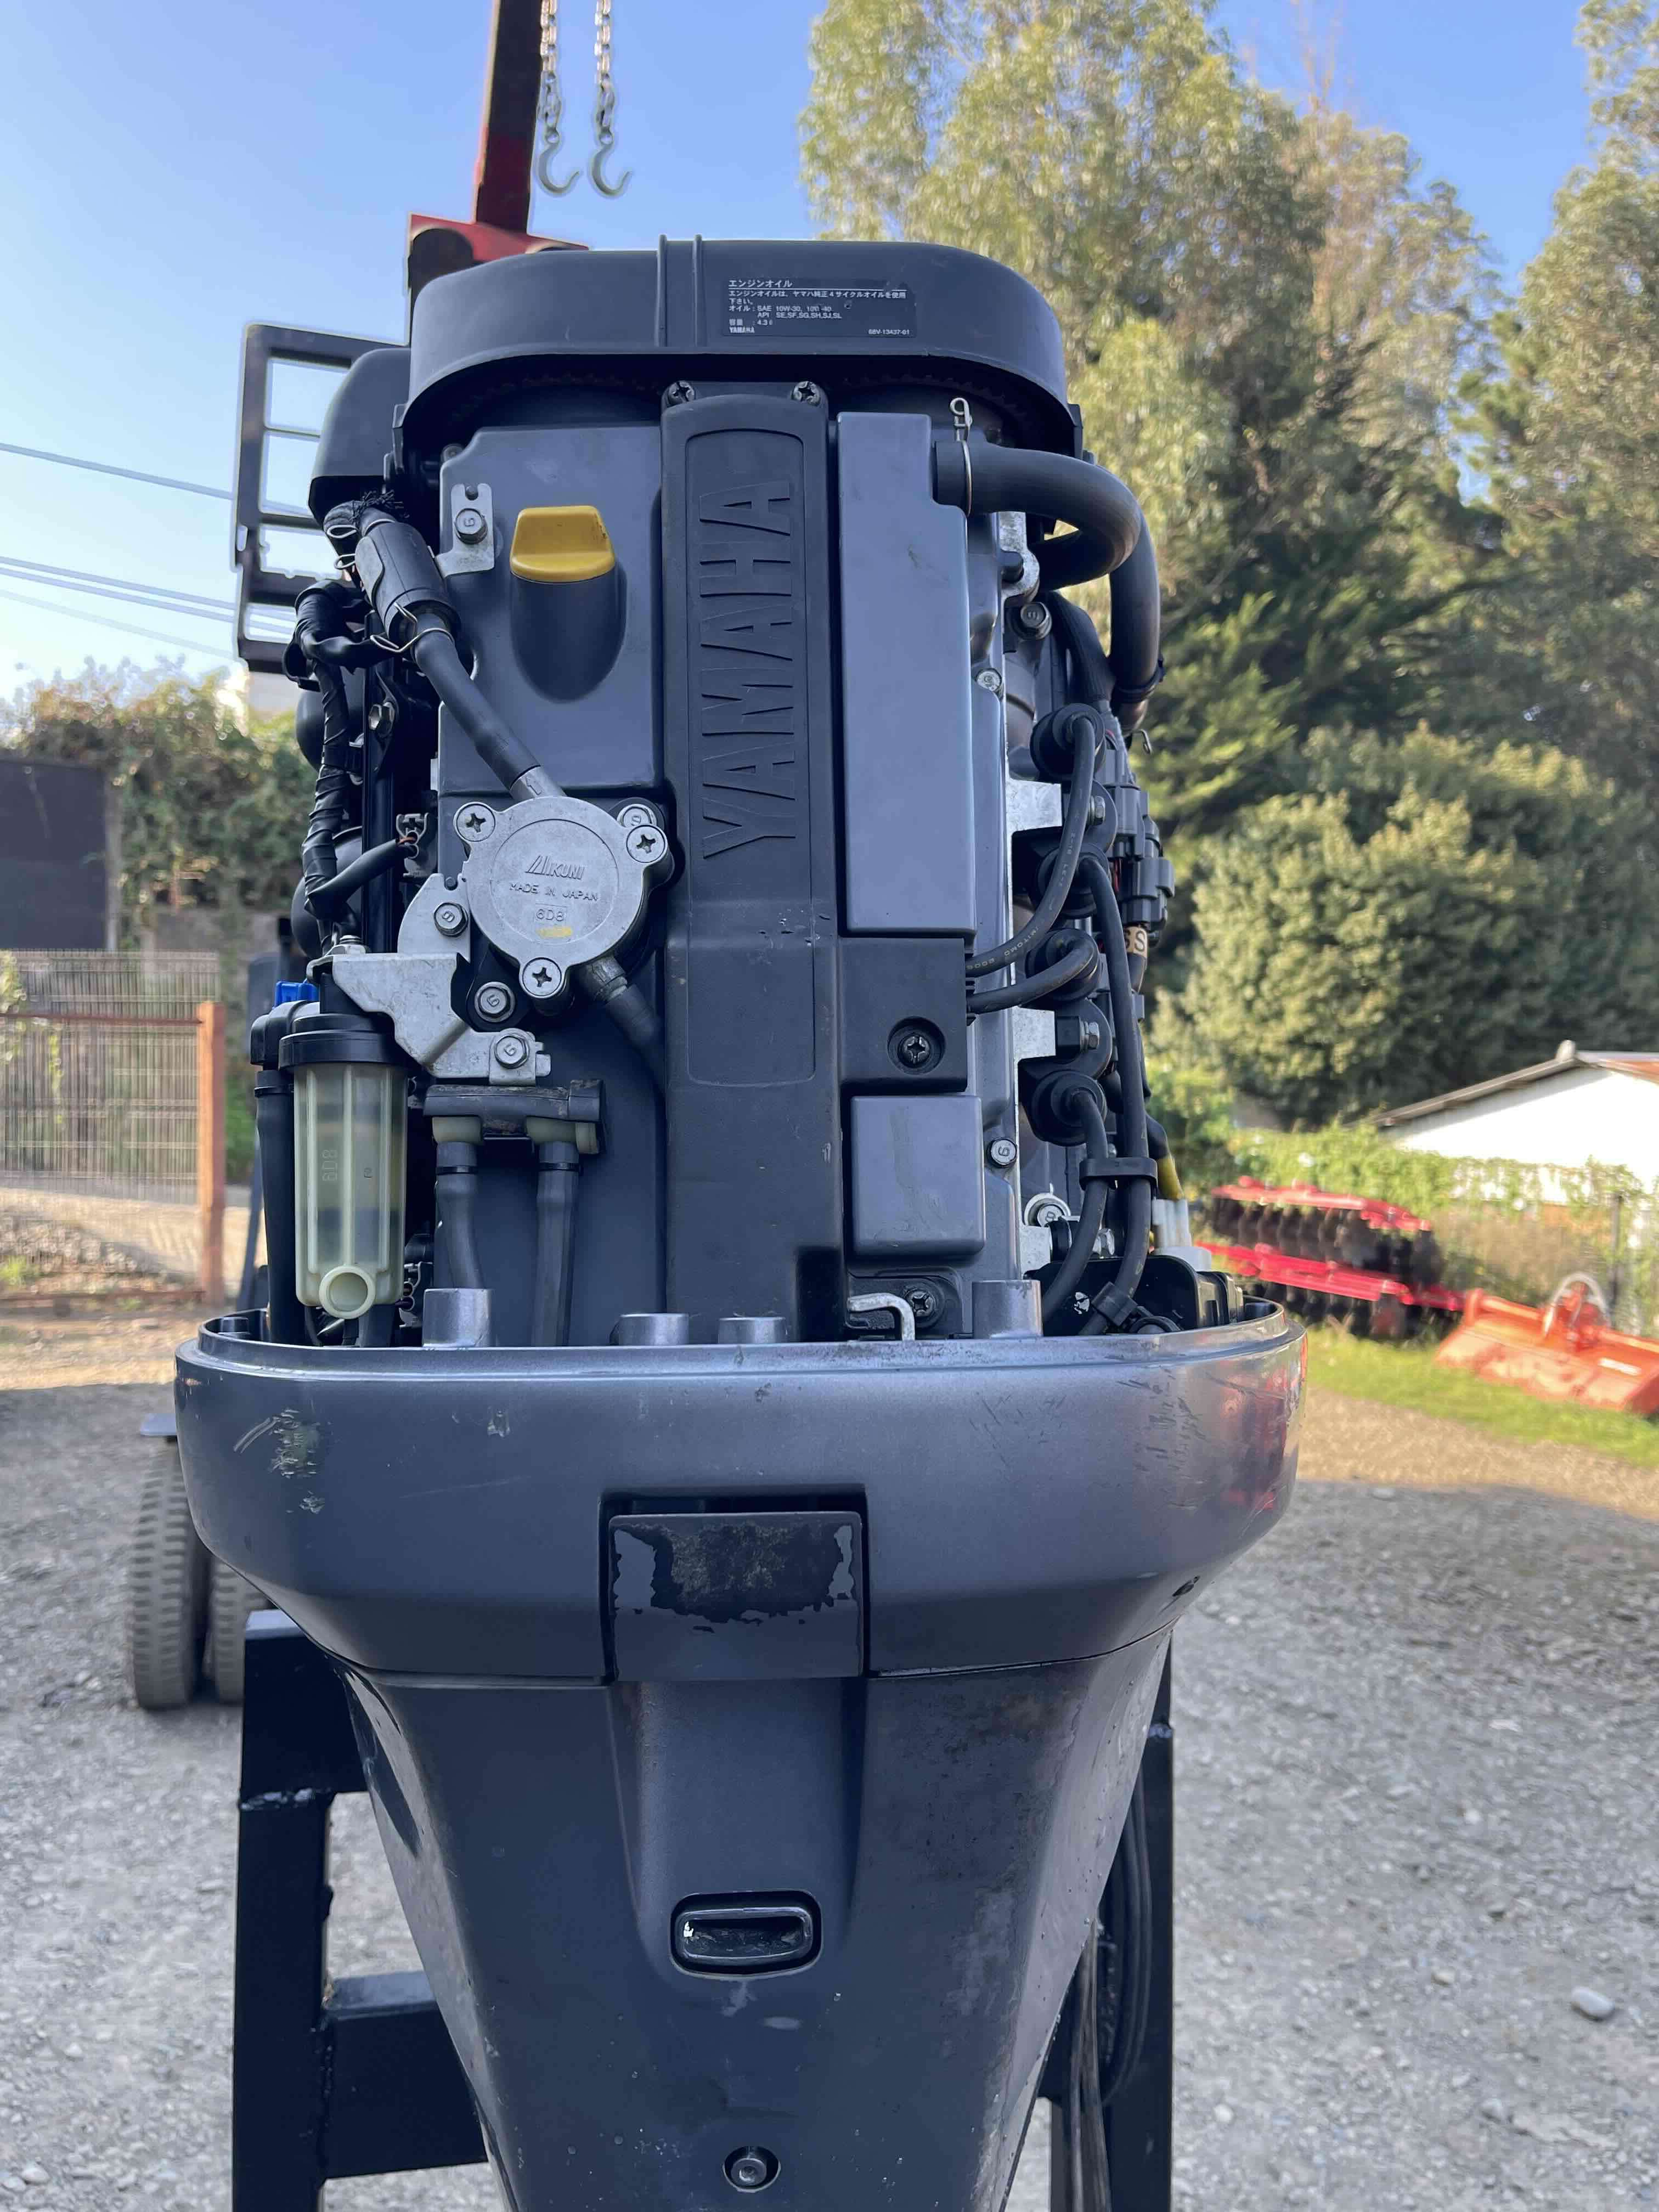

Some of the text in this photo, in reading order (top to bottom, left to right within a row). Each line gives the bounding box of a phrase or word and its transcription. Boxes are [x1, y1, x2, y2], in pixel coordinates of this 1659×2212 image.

[729, 280, 792, 288] エンジンオイル
[699, 479, 796, 860] YAMAHA
[509, 882, 599, 901] MADE IN JAPAN
[536, 909, 566, 922] 6D8
